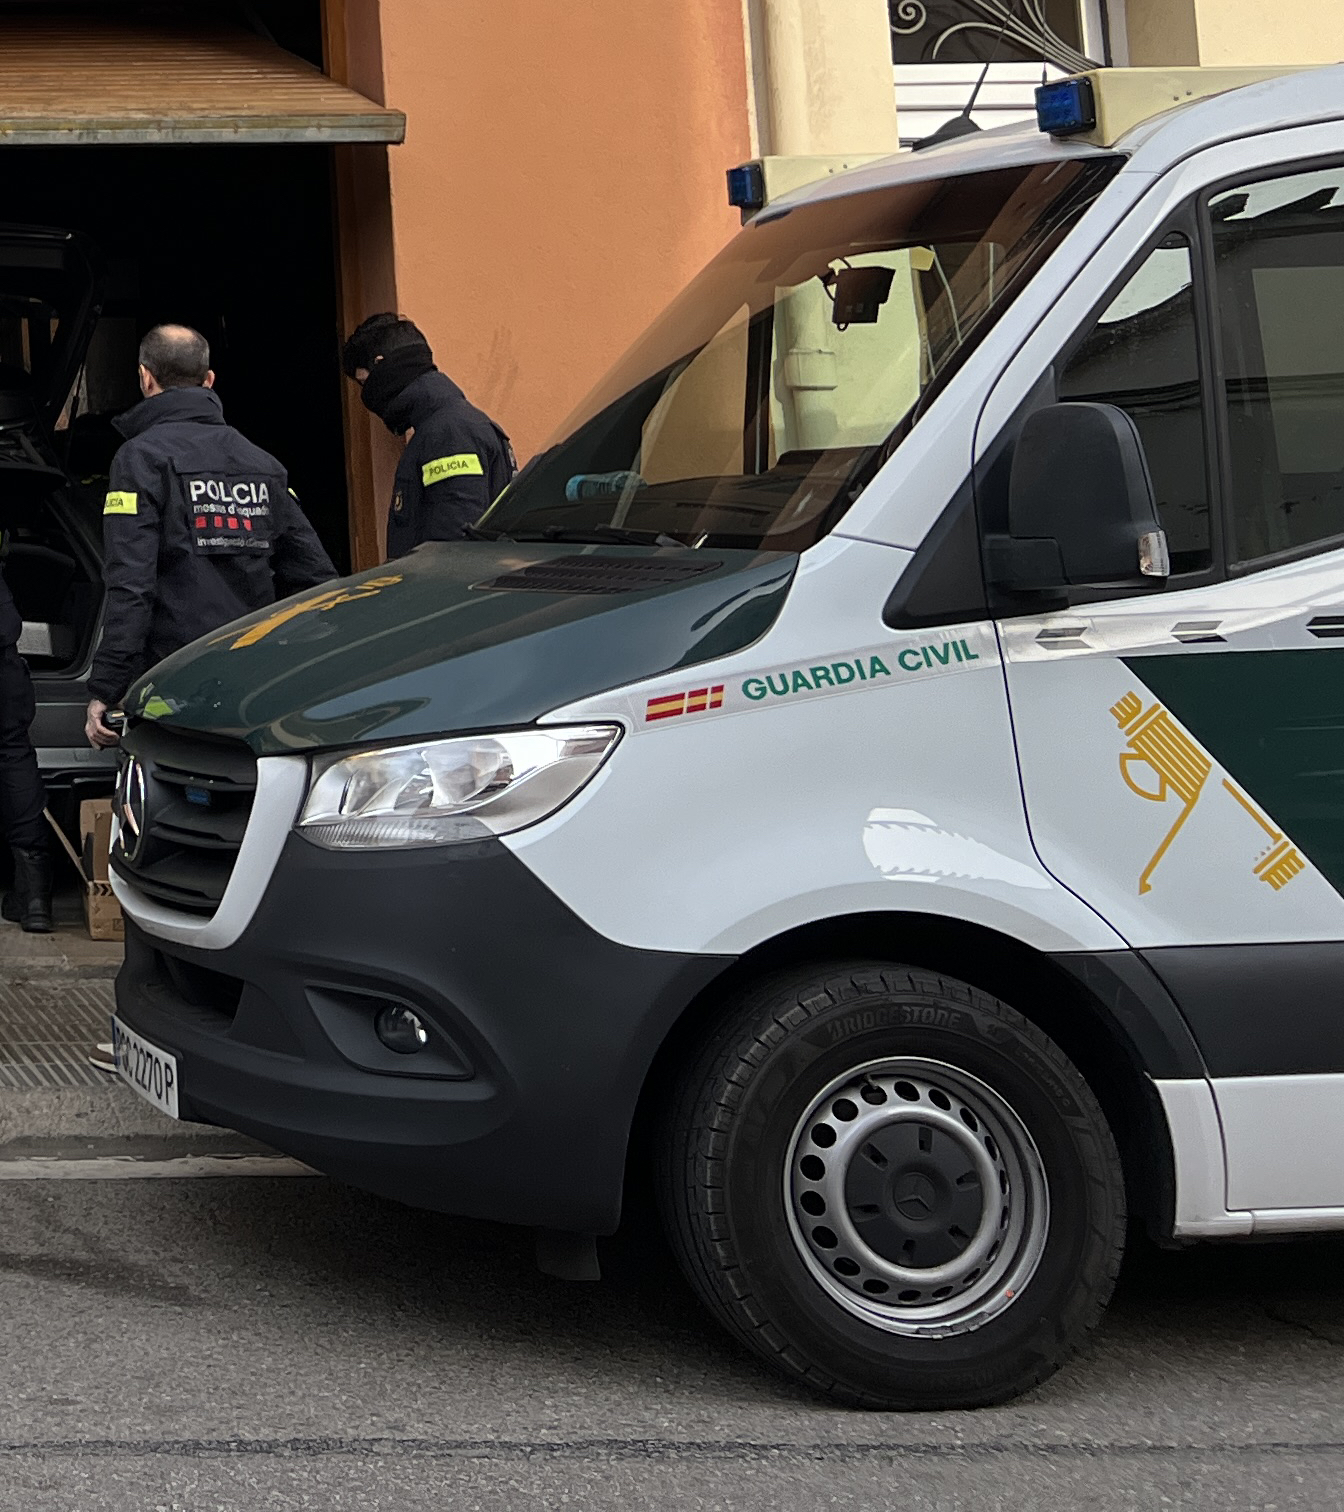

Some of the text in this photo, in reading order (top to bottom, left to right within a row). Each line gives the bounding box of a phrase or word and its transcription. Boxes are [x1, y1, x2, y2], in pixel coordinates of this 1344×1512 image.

[428, 460, 469, 477] POLICIA
[742, 640, 979, 701] GUARDIA CIVIL
